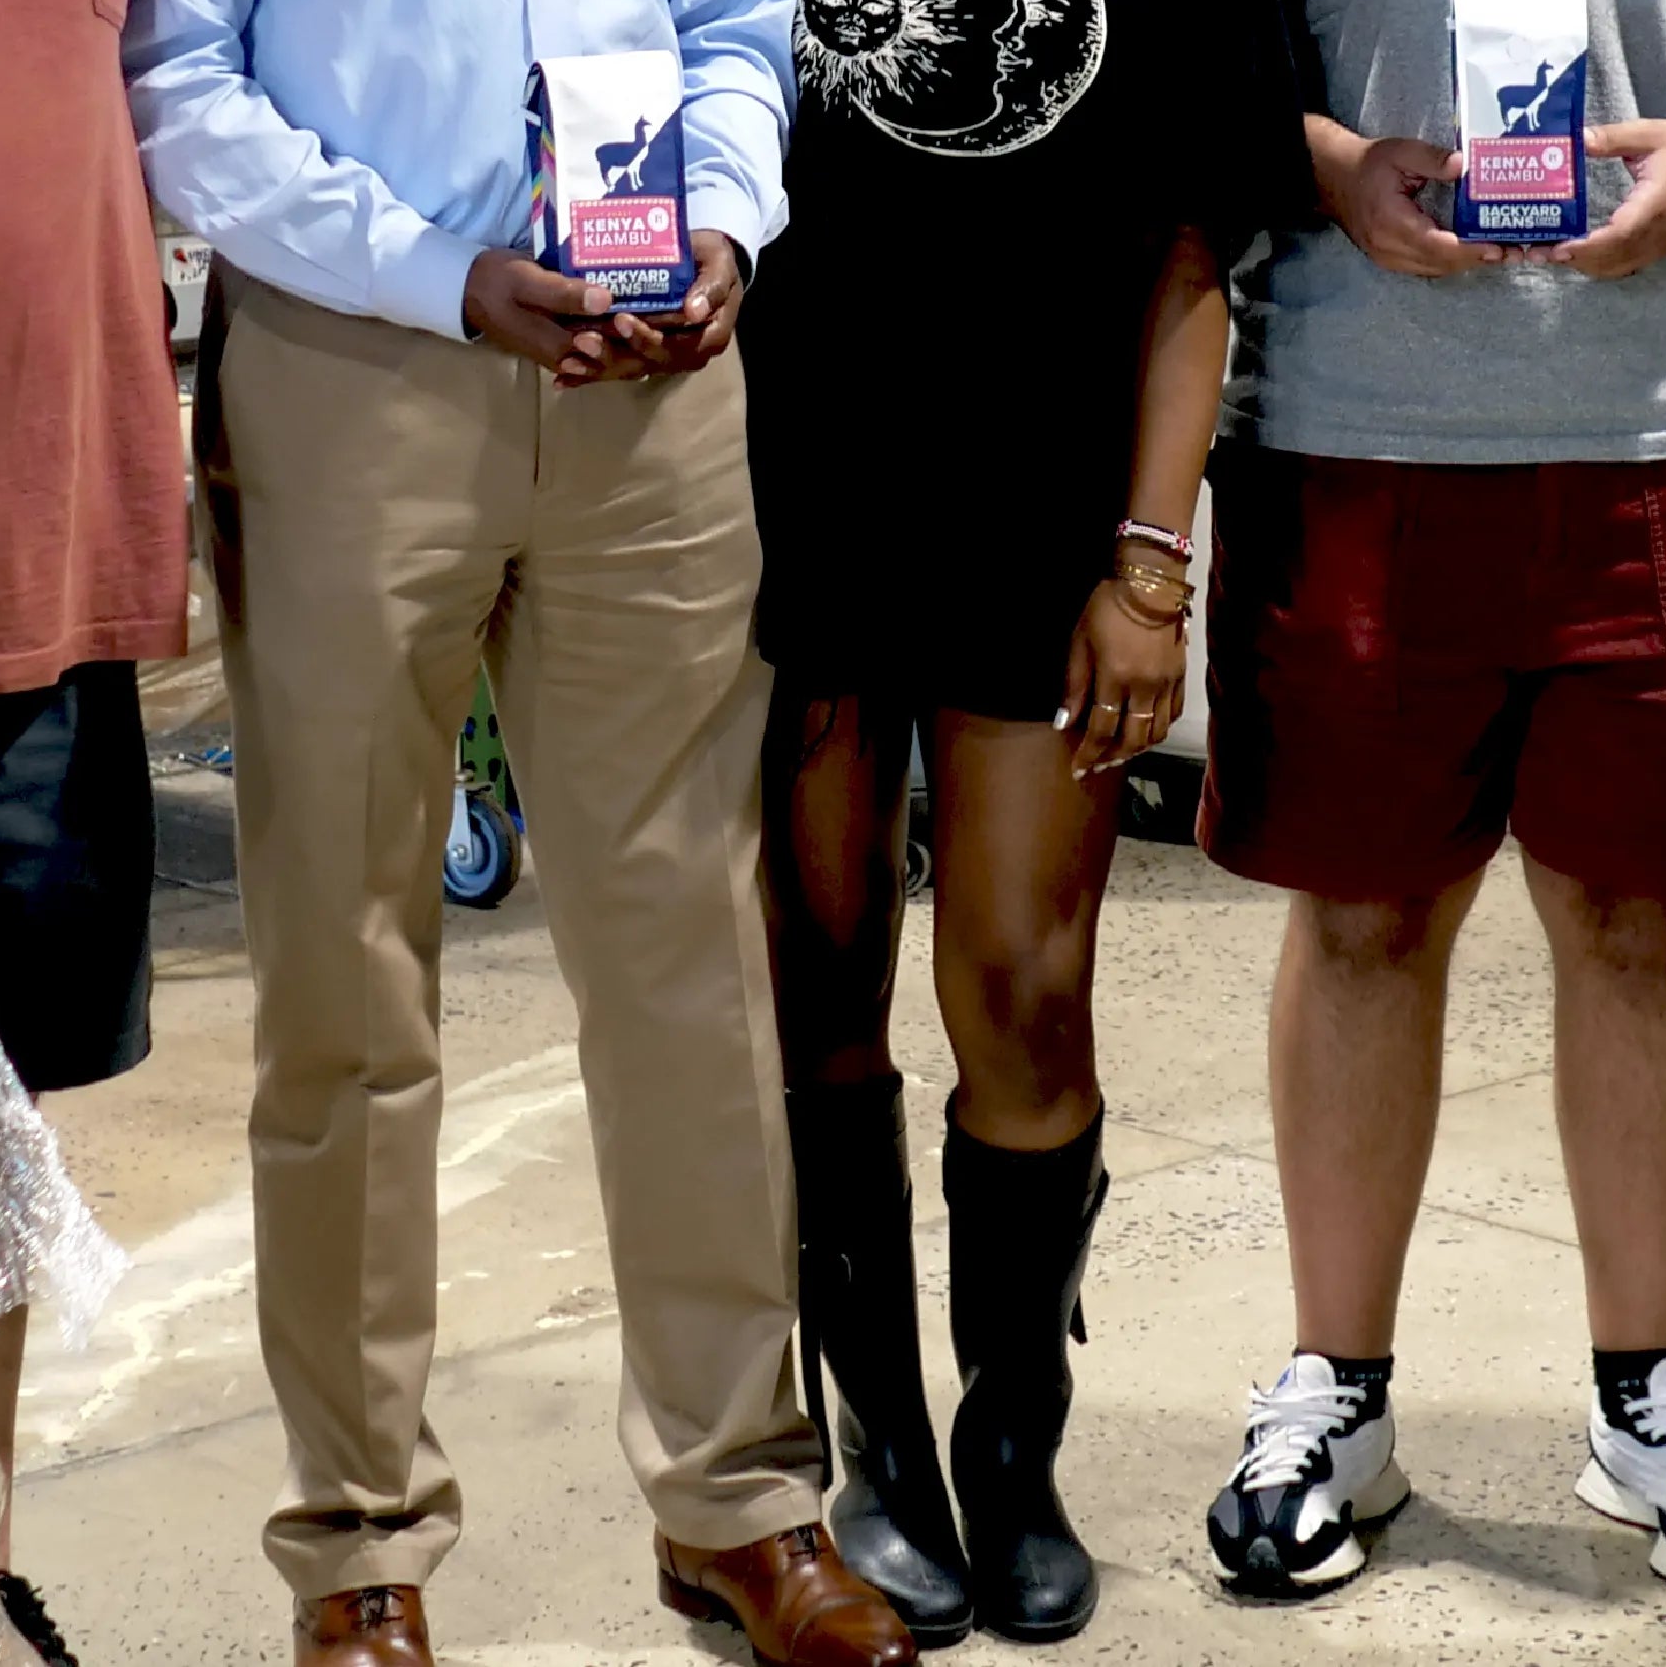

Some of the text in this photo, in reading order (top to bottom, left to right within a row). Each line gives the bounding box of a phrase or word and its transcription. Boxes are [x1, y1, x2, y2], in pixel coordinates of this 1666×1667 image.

[1480, 156, 1539, 170] KENYA
[1480, 170, 1545, 182] KIAMBU
[1479, 204, 1562, 217] BACKYARD
[583, 217, 646, 233] KENYA
[1479, 216, 1534, 229] BEANS
[584, 231, 652, 247] KIAMBU
[585, 269, 670, 286] BACKYARD
